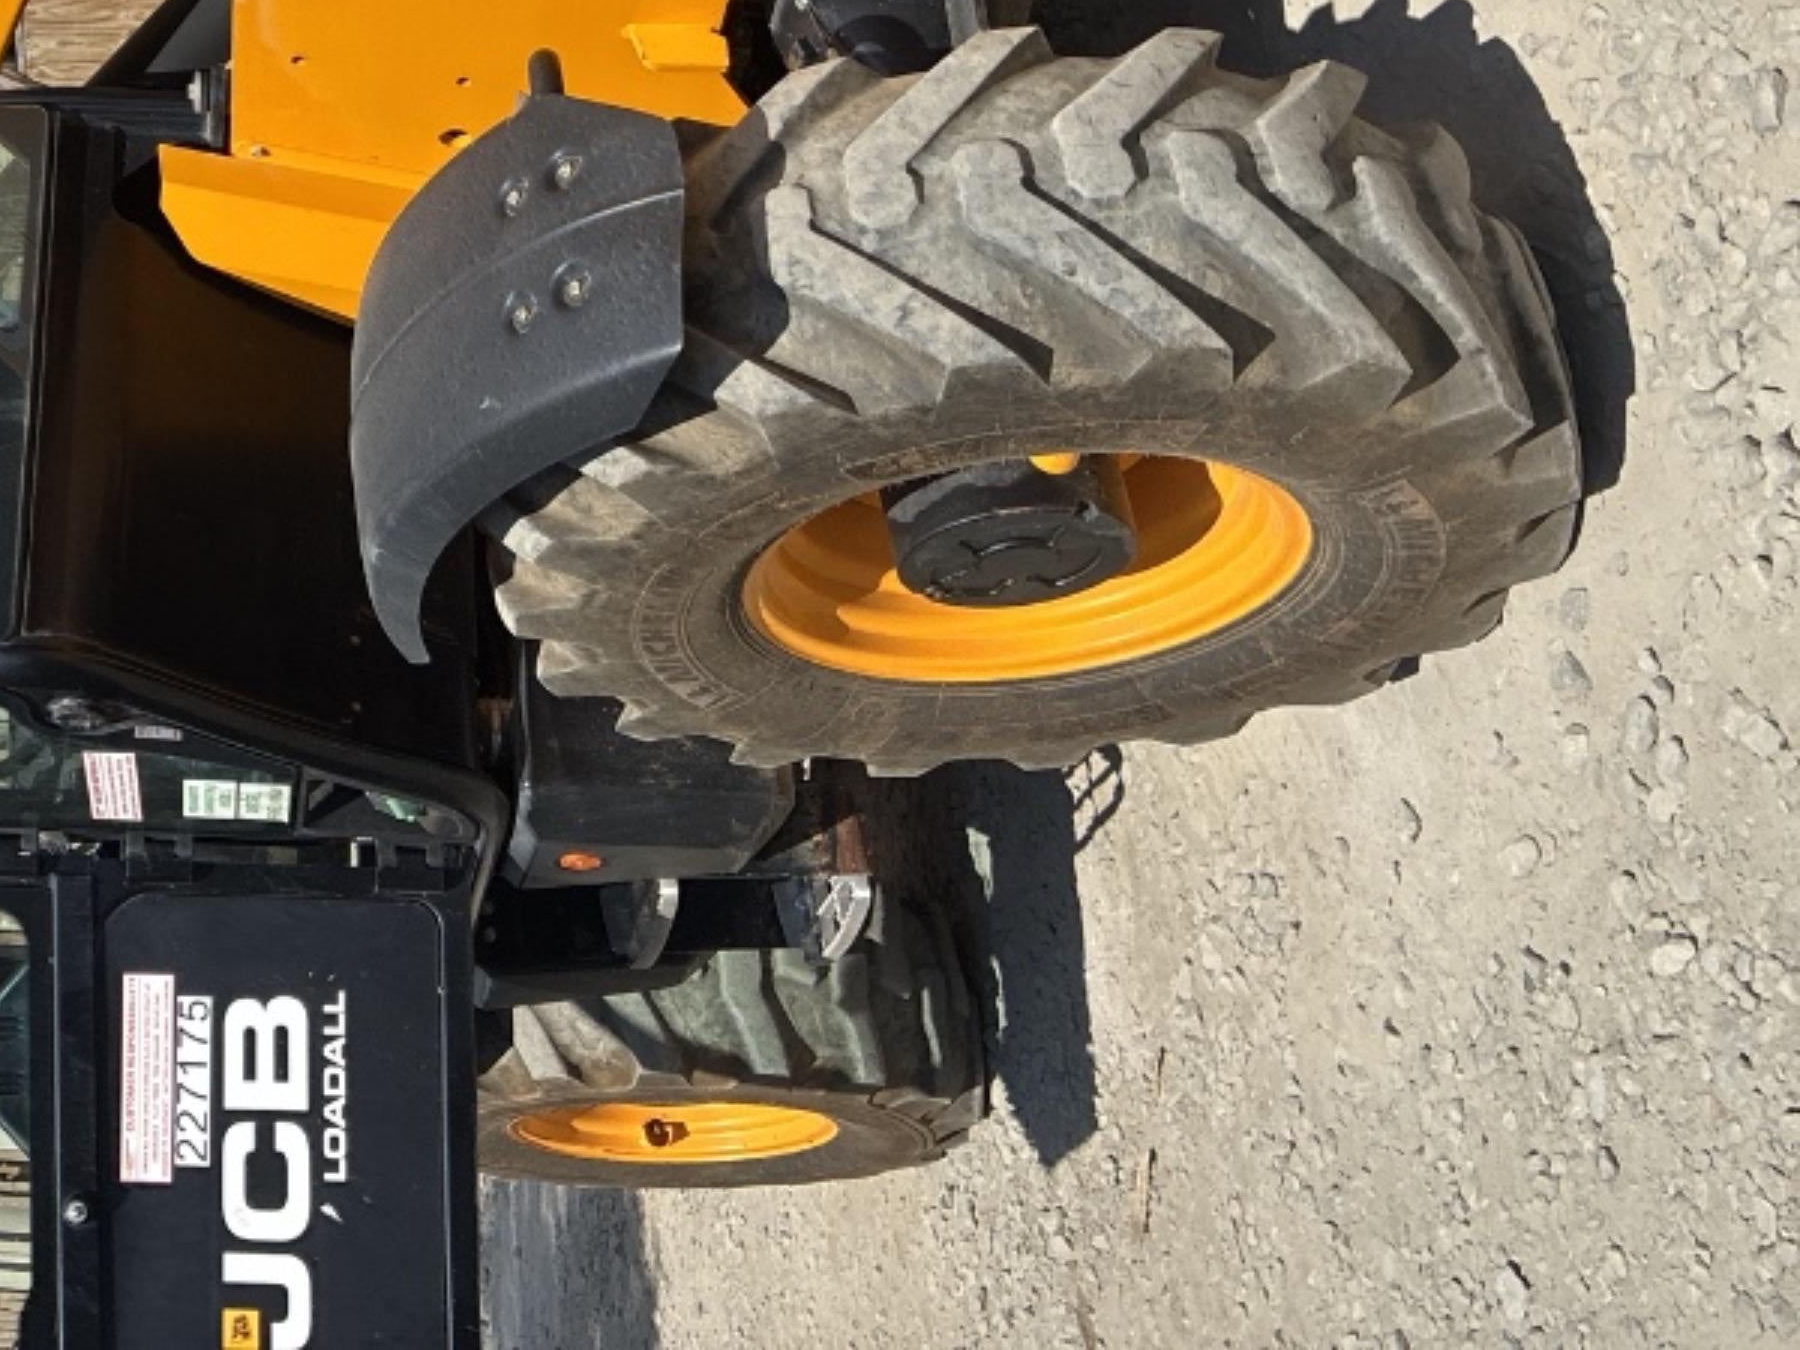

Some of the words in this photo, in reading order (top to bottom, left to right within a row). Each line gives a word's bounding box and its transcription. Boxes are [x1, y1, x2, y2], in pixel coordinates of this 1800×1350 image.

[175, 1000, 211, 1163] 227175
[221, 995, 313, 1350] JCB
[322, 990, 347, 1183] LOADALL
